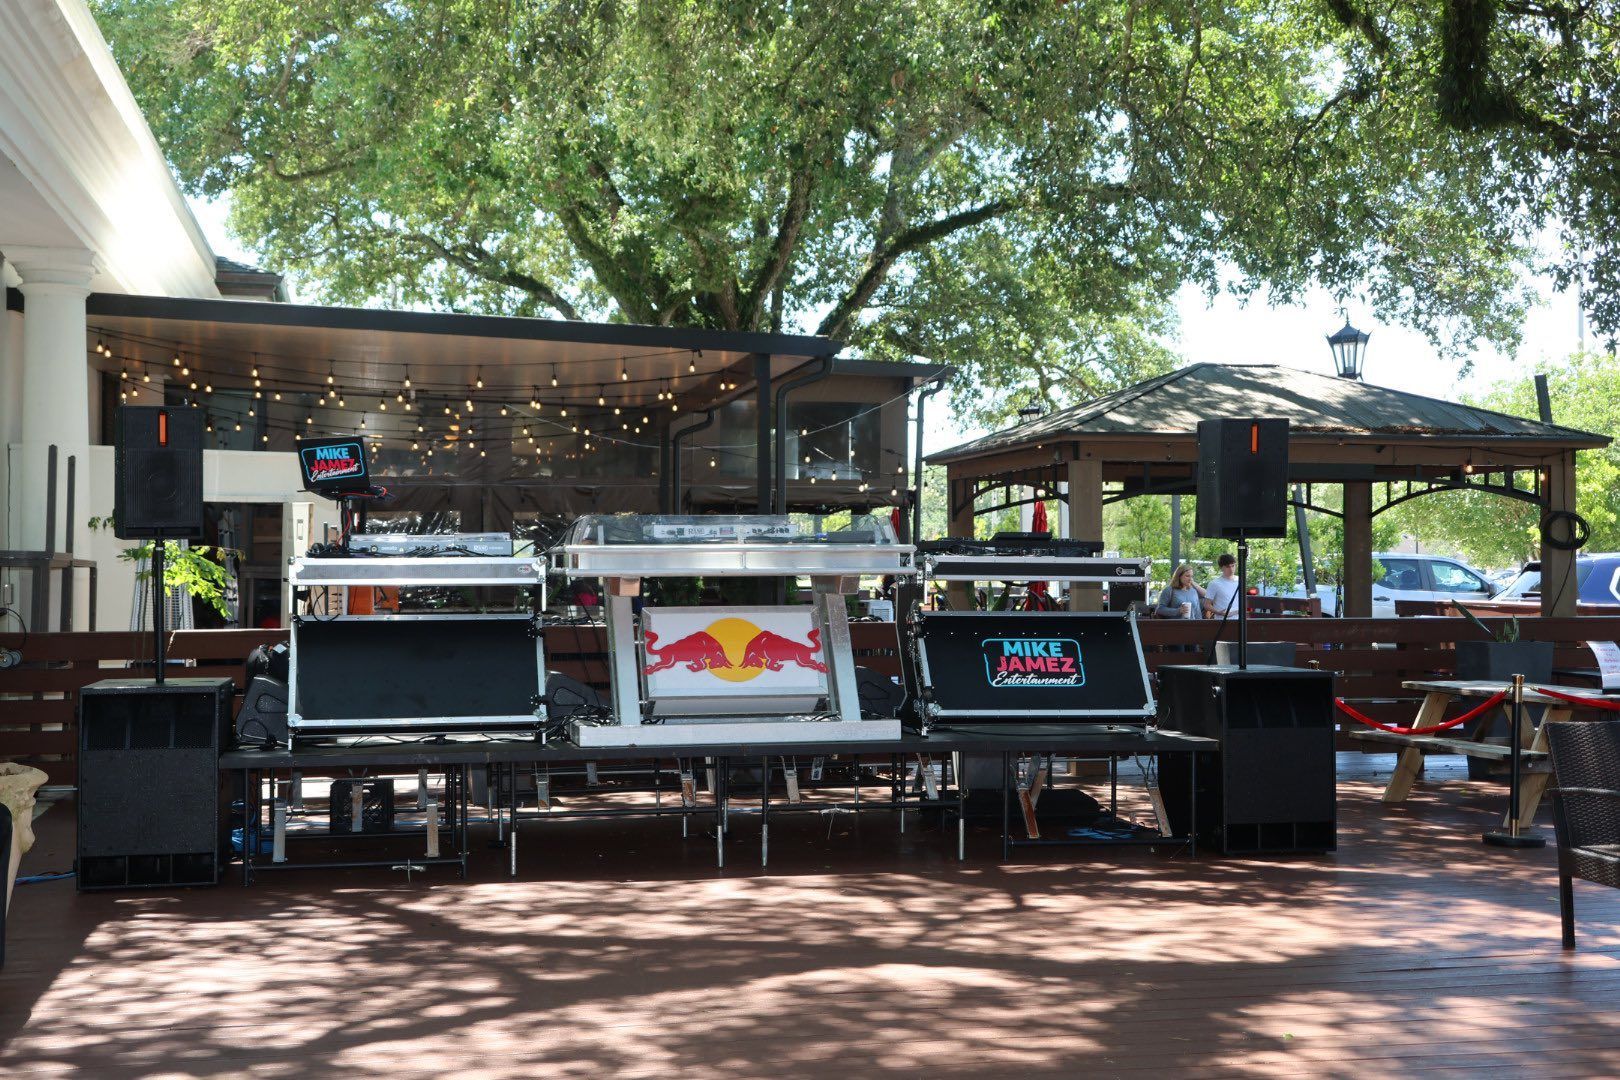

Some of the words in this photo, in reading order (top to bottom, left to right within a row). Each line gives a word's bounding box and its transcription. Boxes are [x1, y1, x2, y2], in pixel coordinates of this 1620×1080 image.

[316, 448, 350, 460] MIKE
[310, 459, 355, 471] JAMEZ
[311, 463, 360, 482] Entertainment
[1003, 641, 1063, 657] MIKE
[997, 656, 1076, 672] JAMEZ
[992, 671, 1081, 687] Entertainment
